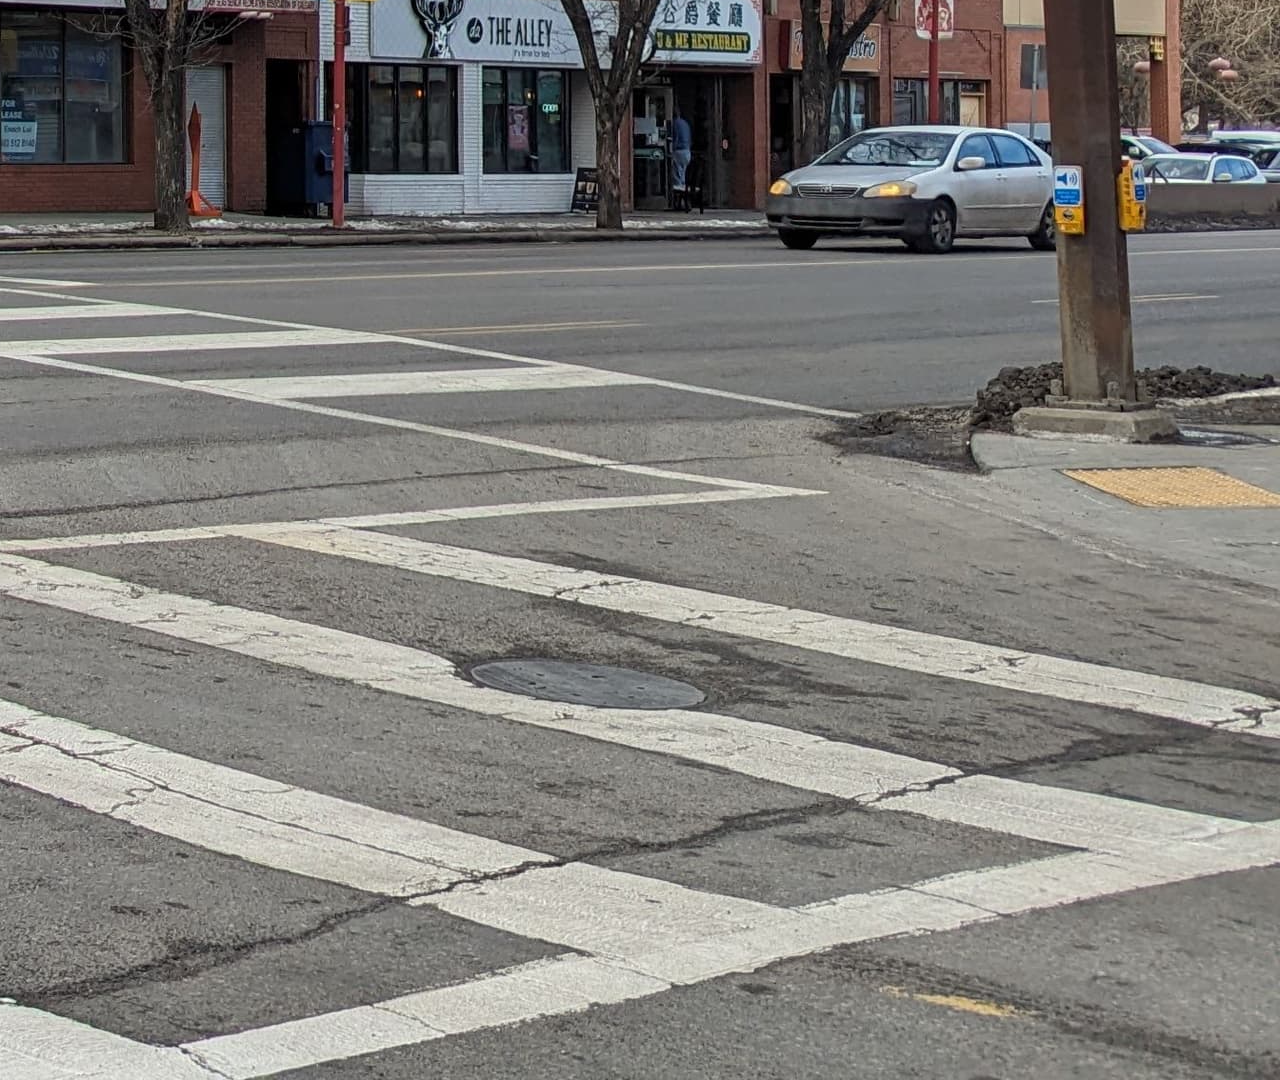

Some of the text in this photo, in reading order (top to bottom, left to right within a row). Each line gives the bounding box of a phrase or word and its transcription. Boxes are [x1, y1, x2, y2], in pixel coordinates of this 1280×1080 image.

[488, 17, 512, 45] THE
[515, 18, 553, 47] ALLEY
[676, 32, 689, 49] ME
[691, 33, 748, 51] RESTAURANT
[848, 31, 876, 58] istro
[1, 111, 23, 119] LEASE
